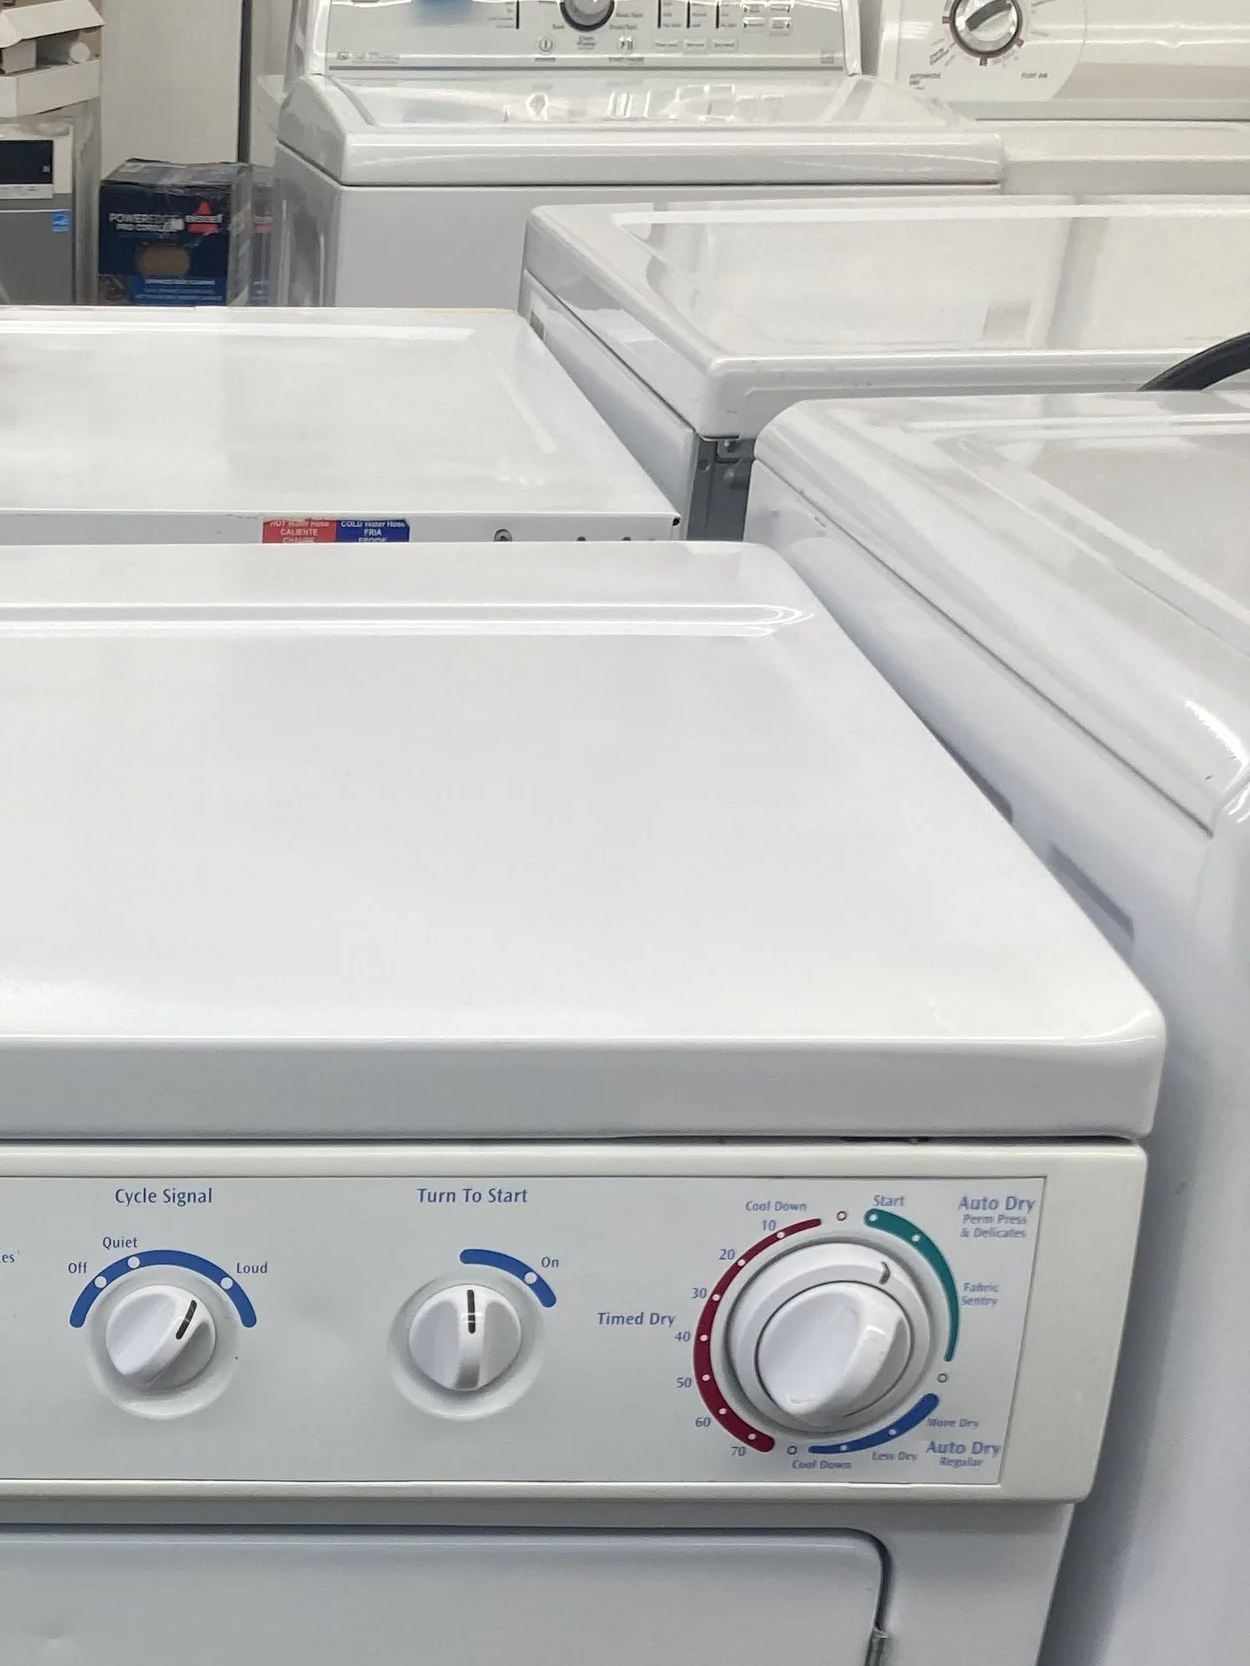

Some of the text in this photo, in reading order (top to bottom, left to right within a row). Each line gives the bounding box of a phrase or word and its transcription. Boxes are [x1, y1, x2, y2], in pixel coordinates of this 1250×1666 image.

[280, 528, 318, 536] CALIENTE
[363, 528, 382, 536] FRIA
[116, 1188, 212, 1207] Cycle Signal
[417, 1188, 527, 1203] Turn To Start
[874, 1195, 904, 1206] Start
[746, 1201, 806, 1211] Cool Down
[958, 1196, 1035, 1213] Auto Dry
[963, 1214, 1027, 1225] Perm Press
[761, 1220, 776, 1232] 10
[960, 1227, 1025, 1238] & Delicates
[103, 1237, 137, 1250] Quiet
[719, 1249, 735, 1260] 20
[68, 1262, 86, 1273] Off
[237, 1262, 267, 1273] Loud
[541, 1257, 559, 1268] On
[964, 1282, 998, 1292] Fabric
[692, 1288, 707, 1299] 30
[961, 1296, 998, 1307] Sentry
[598, 1312, 675, 1327] Timed Dry
[675, 1331, 691, 1342] 40
[677, 1377, 692, 1388] 50
[695, 1417, 711, 1427] 60
[927, 1418, 978, 1428] More Dry
[731, 1446, 746, 1456] 70
[927, 1441, 1001, 1456] Auto Dry
[872, 1451, 917, 1460] Less Dry
[792, 1460, 851, 1469] Cool Down
[940, 1456, 983, 1468] Regular
